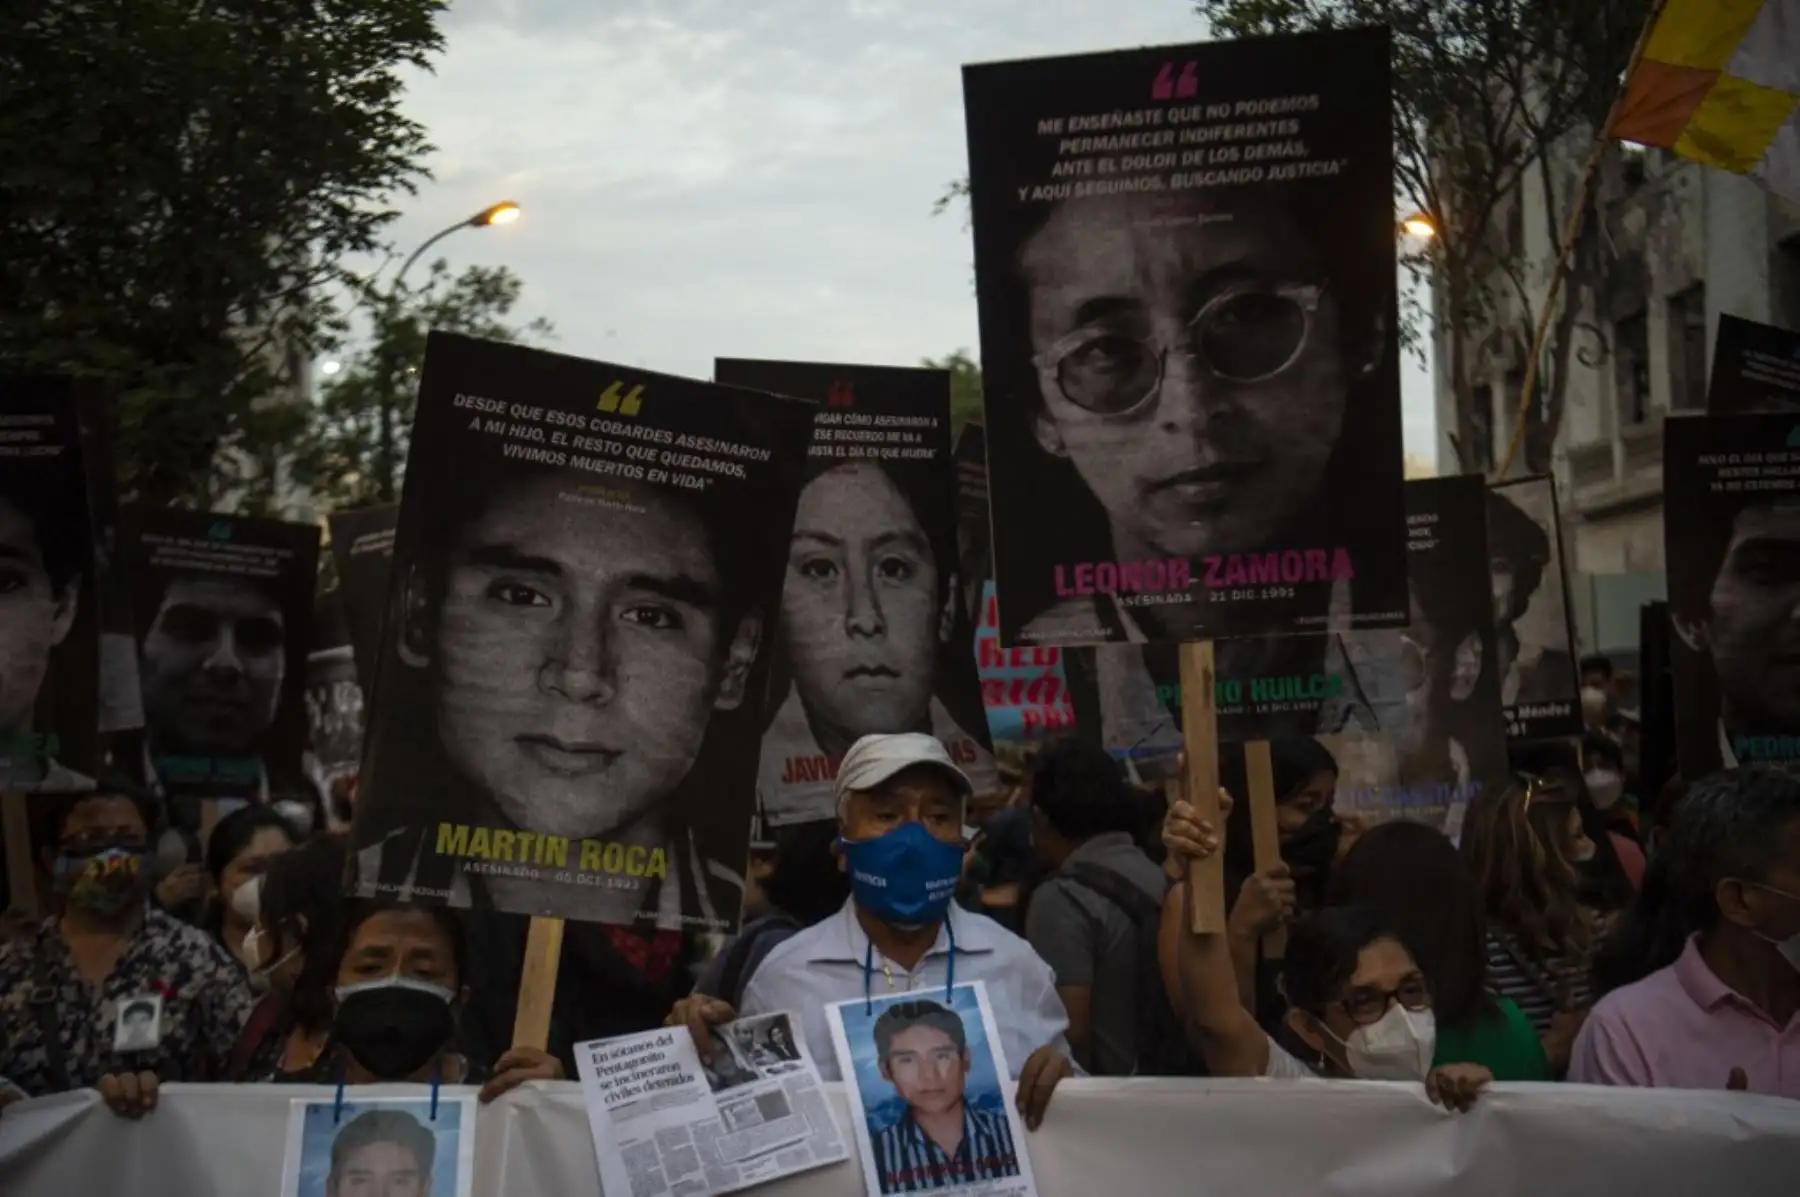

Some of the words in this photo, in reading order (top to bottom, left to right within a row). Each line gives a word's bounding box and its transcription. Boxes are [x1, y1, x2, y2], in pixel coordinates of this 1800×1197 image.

[1037, 117, 1063, 135] ME
[1068, 107, 1164, 132] ENSEÑASTE
[1168, 104, 1200, 122] QUE
[1206, 103, 1231, 119] NO
[1236, 94, 1319, 116] PODEMOS
[1059, 130, 1175, 155] PERMANECER
[1179, 118, 1300, 146] INDIFERENTES
[1051, 158, 1093, 177] ANTE
[1097, 157, 1116, 174] EL
[1121, 152, 1177, 172] DOLOR
[1182, 149, 1203, 166] DE
[1209, 146, 1240, 164] LOS
[1018, 186, 1029, 201] Y
[1170, 168, 1262, 190] BUSCANDO
[453, 393, 506, 415] DESDE
[510, 403, 542, 421] QUE
[546, 410, 586, 429] ESOS
[590, 418, 672, 445] COBARDES
[676, 432, 771, 462] ASESINARON
[469, 417, 481, 431] A
[485, 421, 505, 436] MI
[509, 425, 546, 444] HIJO,
[551, 432, 569, 446] EL
[573, 435, 623, 456] RESTO
[626, 444, 656, 462] QUE
[660, 450, 747, 479] QUEDAMOS,
[880, 447, 900, 460] QUE
[503, 445, 567, 466] VIVIMOS
[570, 456, 643, 480] MUERTOS
[648, 468, 668, 484] EN
[1057, 561, 1190, 597] LEONOR
[1204, 547, 1354, 587] ZAMORA
[1116, 591, 1192, 606] ASESINADA
[463, 862, 540, 880] ASESINADO
[579, 839, 668, 880] ROCA
[592, 1052, 609, 1065] En
[656, 1034, 673, 1047] del
[595, 1053, 665, 1078] Pentagonito
[600, 1080, 612, 1090] se
[613, 1062, 681, 1087] incineraron
[604, 1084, 642, 1103] civiles
[643, 1073, 695, 1092] detenidos
